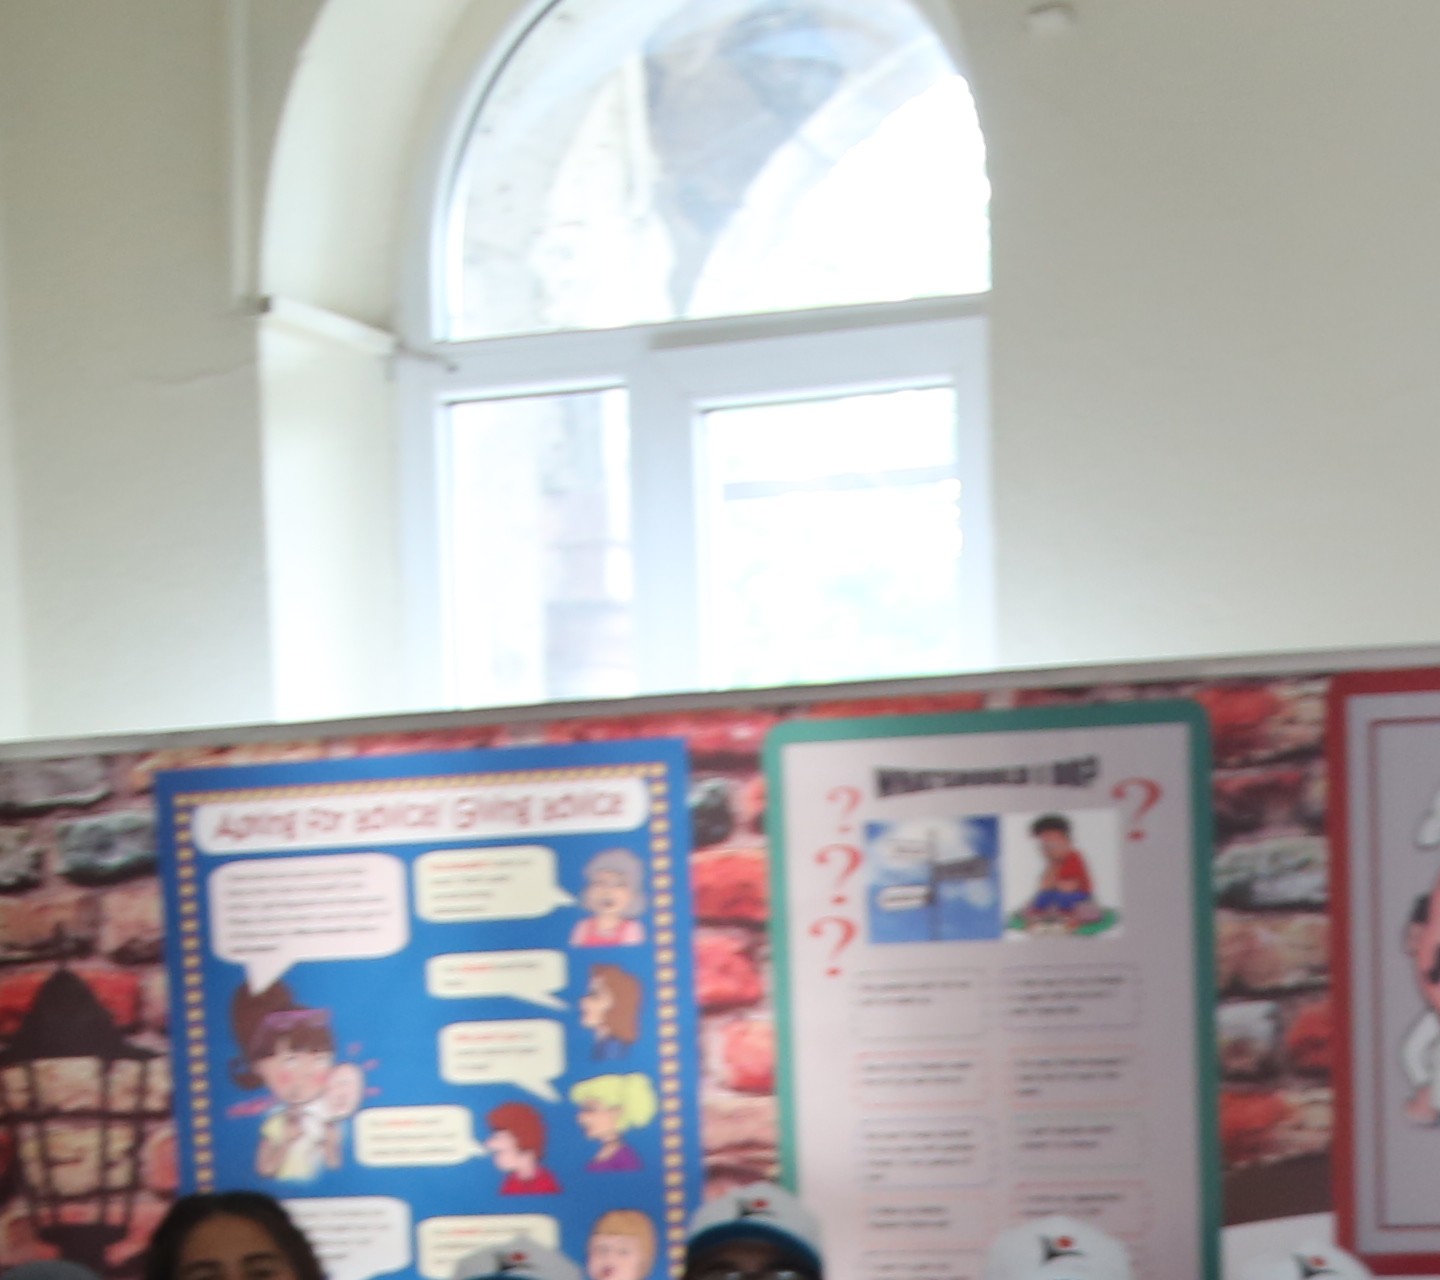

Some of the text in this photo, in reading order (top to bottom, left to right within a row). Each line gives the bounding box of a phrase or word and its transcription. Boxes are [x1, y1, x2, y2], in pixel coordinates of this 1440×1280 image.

[214, 809, 298, 842] Asking
[453, 795, 533, 829] Giving
[540, 790, 628, 821] advice
